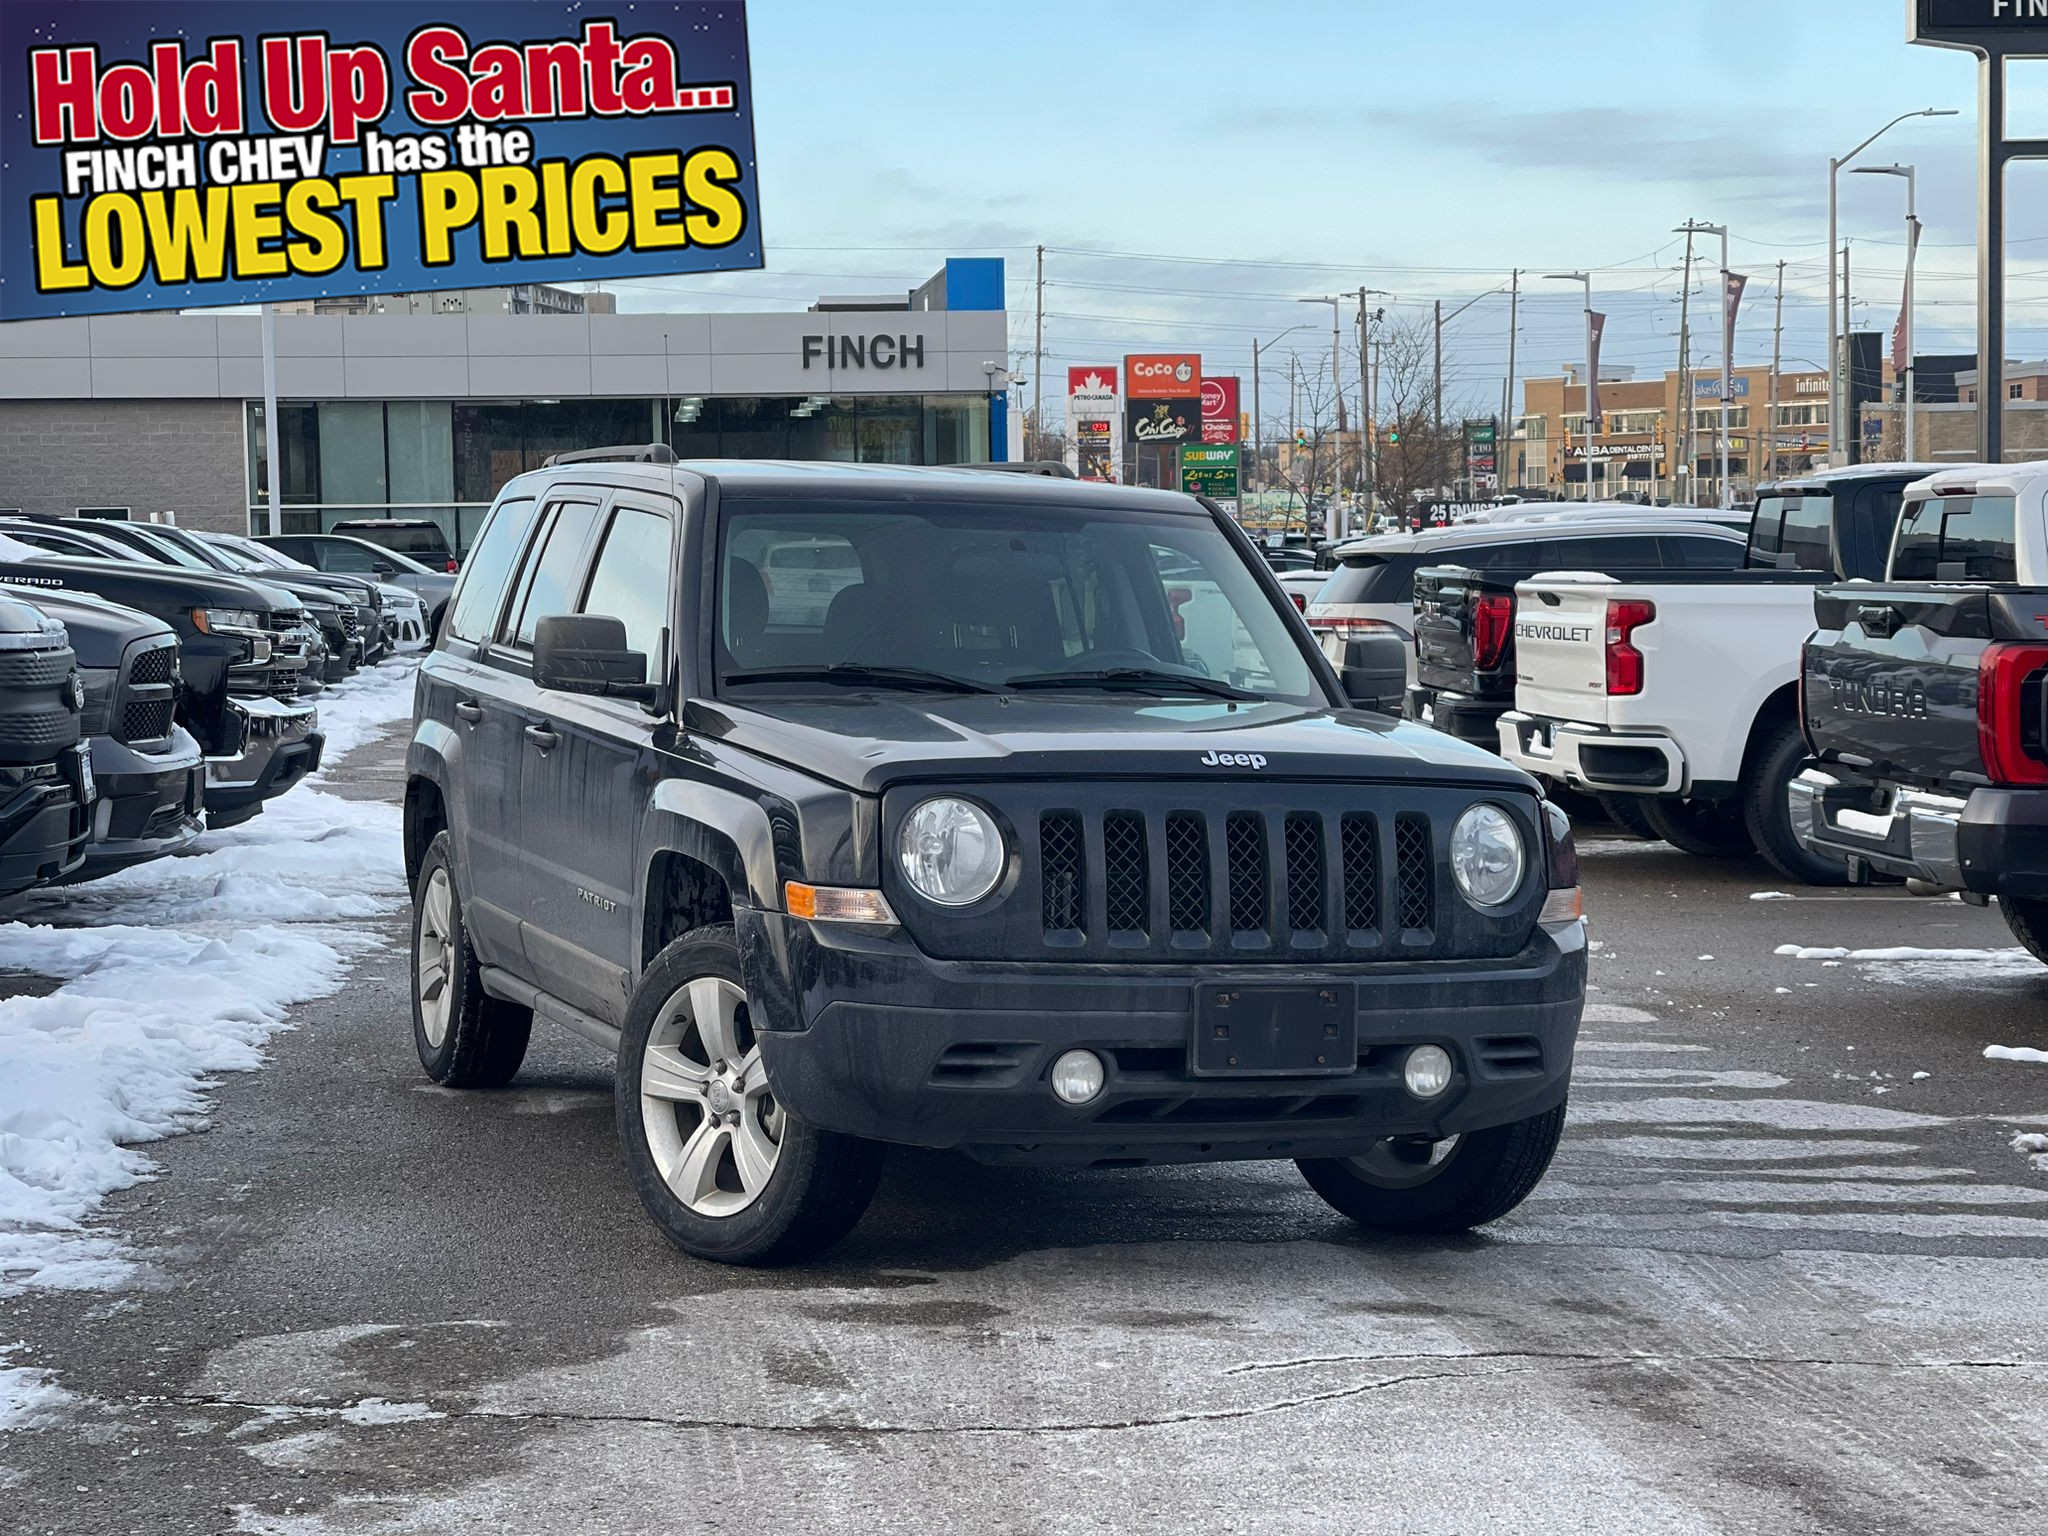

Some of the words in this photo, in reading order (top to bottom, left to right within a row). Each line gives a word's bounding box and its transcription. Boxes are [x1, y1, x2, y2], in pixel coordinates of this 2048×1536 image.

[803, 334, 924, 369] FINCH
[1134, 362, 1173, 376] CoCo
[1696, 384, 1712, 395] ake
[1184, 450, 1233, 461] SUBWAY
[1610, 446, 1636, 454] DENTAL
[1430, 503, 1447, 521] 25
[1449, 503, 1503, 520] ENVIS
[1515, 623, 1593, 642] CHEVROLET
[1829, 679, 1927, 720] TUNDRA
[1201, 749, 1267, 770] Jeep
[577, 887, 617, 914] PATRIOT
